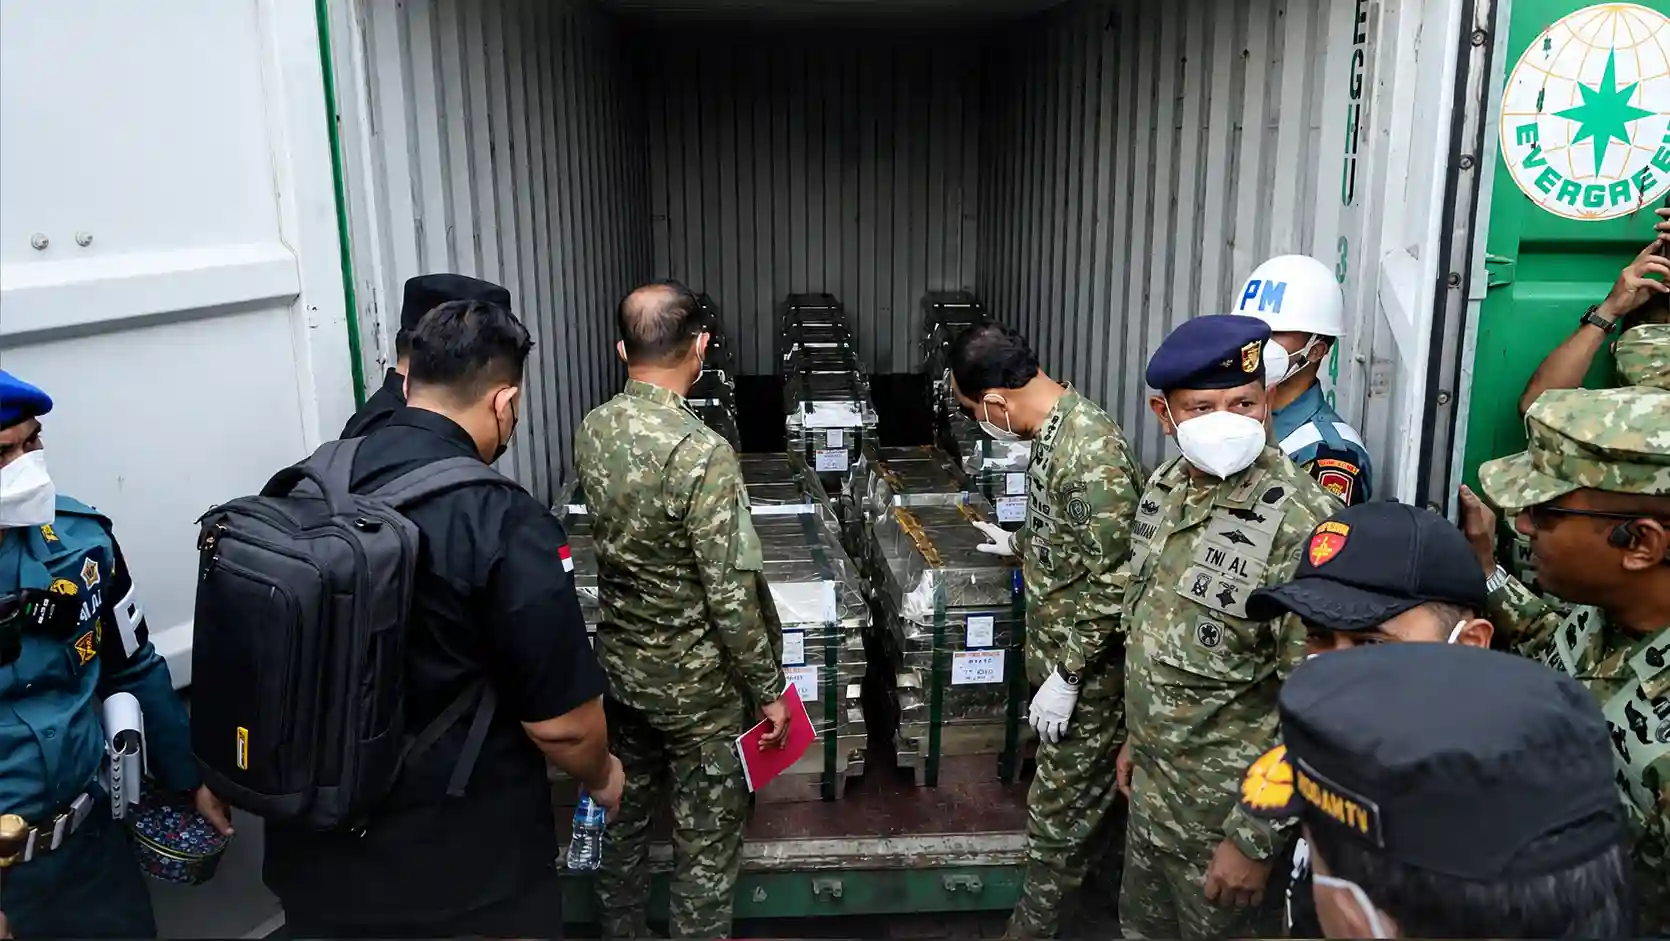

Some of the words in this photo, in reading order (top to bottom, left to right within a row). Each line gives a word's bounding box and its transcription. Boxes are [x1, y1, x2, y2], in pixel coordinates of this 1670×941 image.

[1239, 279, 1287, 314] PM
[1203, 547, 1226, 567] TNI
[1228, 556, 1248, 578] AL
